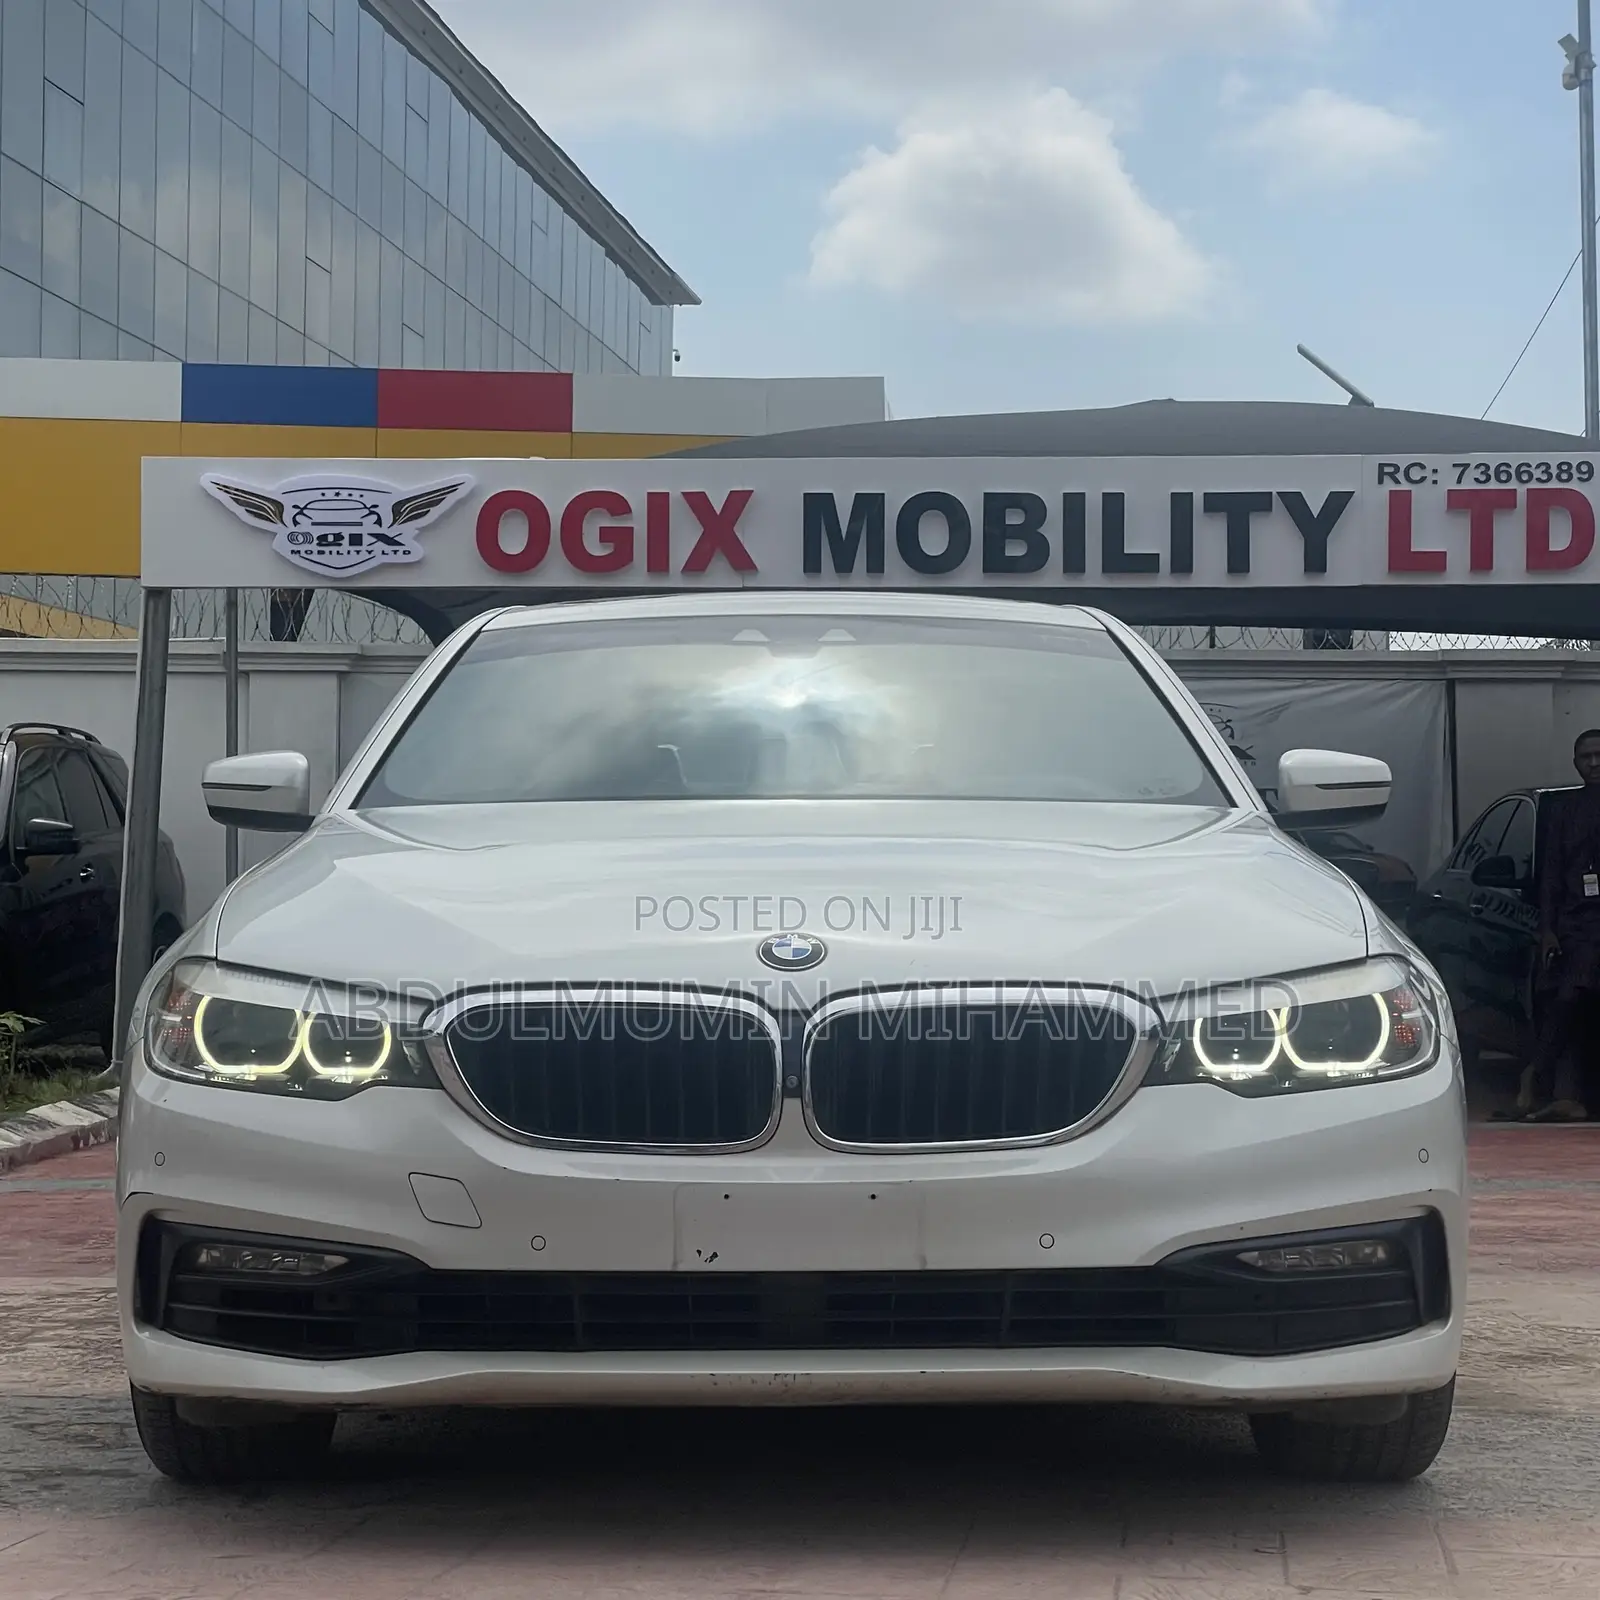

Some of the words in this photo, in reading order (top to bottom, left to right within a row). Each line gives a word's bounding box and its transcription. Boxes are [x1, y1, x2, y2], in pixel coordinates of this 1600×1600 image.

[1377, 462, 1439, 485] RC:
[1452, 460, 1595, 485] 7366389
[476, 489, 759, 574] OGIX
[803, 490, 1355, 575] MOBILITY
[1387, 487, 1596, 574] LTD
